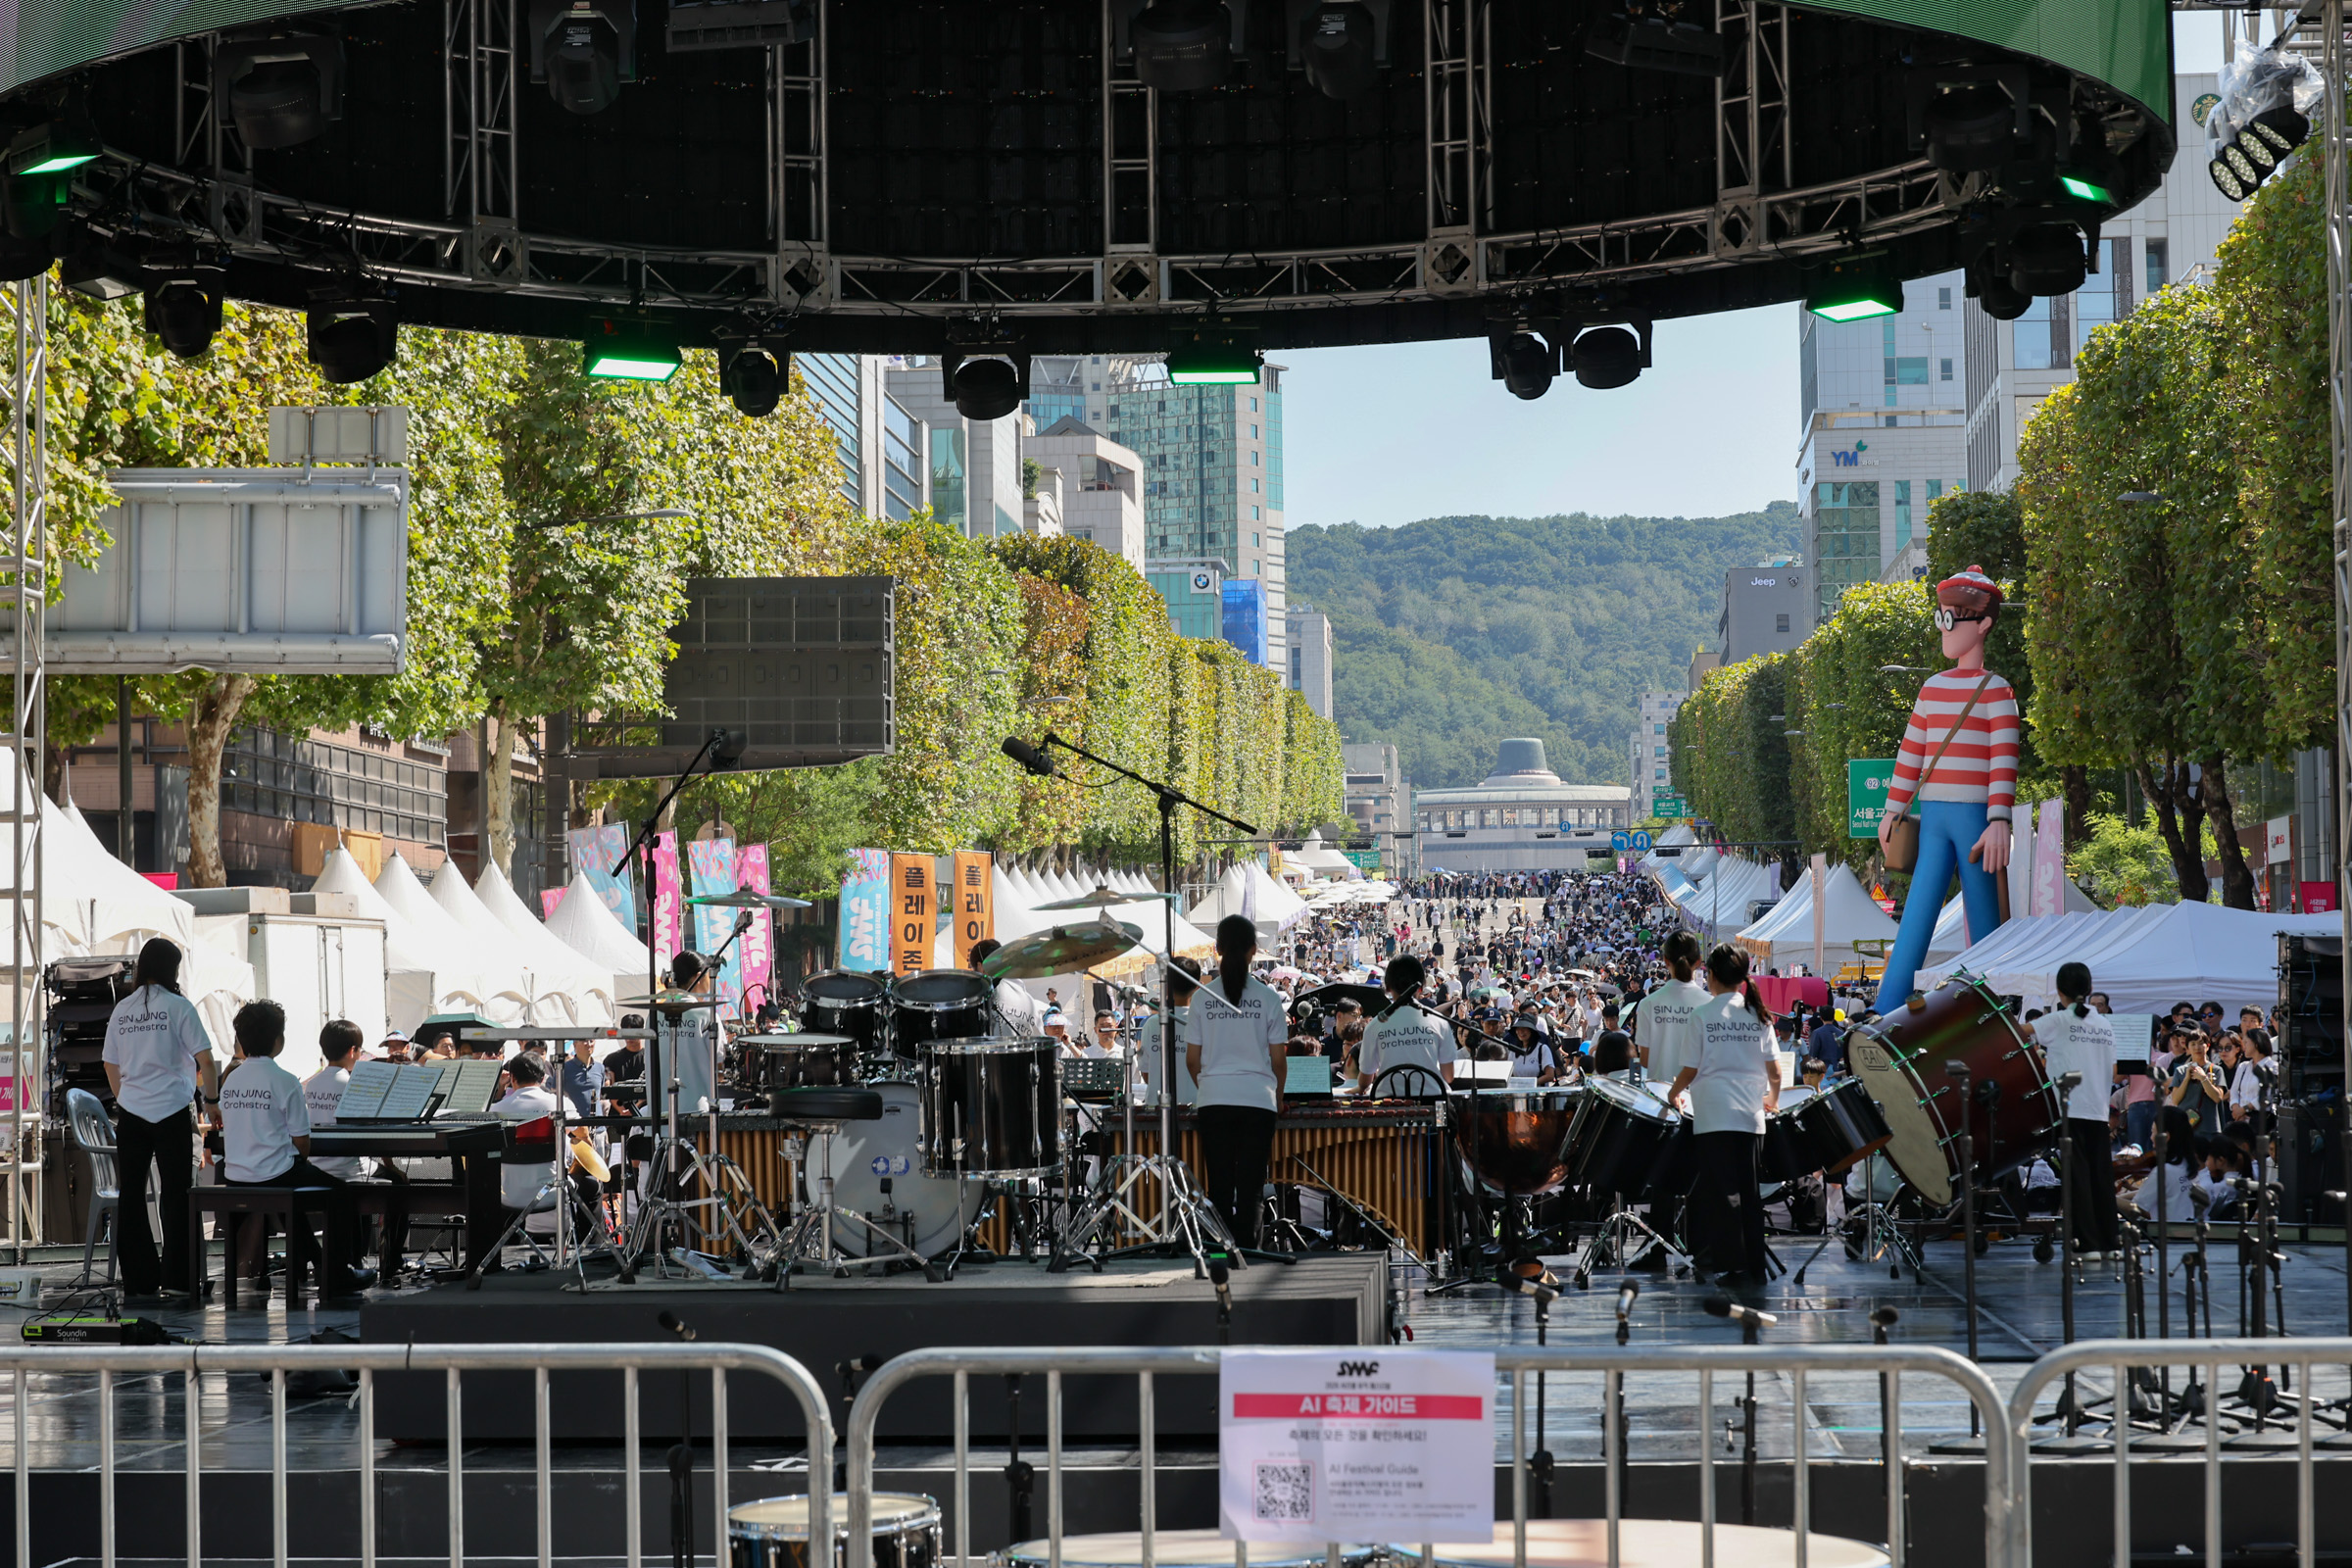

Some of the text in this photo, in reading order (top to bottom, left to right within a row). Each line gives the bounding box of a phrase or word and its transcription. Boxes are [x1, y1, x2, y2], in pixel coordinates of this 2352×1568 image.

[1831, 451, 1858, 466] YM
[1751, 577, 1776, 587] Jeep
[902, 866, 925, 971] 플레이존
[1206, 1009, 1261, 1020] Orchestra
[1653, 1005, 1694, 1014] SIN JUN
[119, 1011, 168, 1025] SIN JUNG
[1006, 1007, 1035, 1027] JUNG
[119, 1023, 168, 1035] Orchestra
[1378, 1026, 1434, 1041] SIN JUNG
[1706, 1022, 1761, 1033] SIN JUNG
[2069, 1025, 2112, 1037] SIN JUNG
[1381, 1037, 1434, 1050] Orchestra
[1707, 1034, 1760, 1044] Orchestra
[2069, 1035, 2113, 1046] Orchestra
[222, 1090, 271, 1100] SIN JUNG
[223, 1101, 270, 1110] Orchestra
[57, 1329, 87, 1338] Soundin
[1299, 1396, 1417, 1414] AI 축제 가이드
[1289, 1430, 1320, 1442] 축제의
[1324, 1430, 1344, 1442] 모든
[1329, 1463, 1419, 1475] AI Festival Guide
